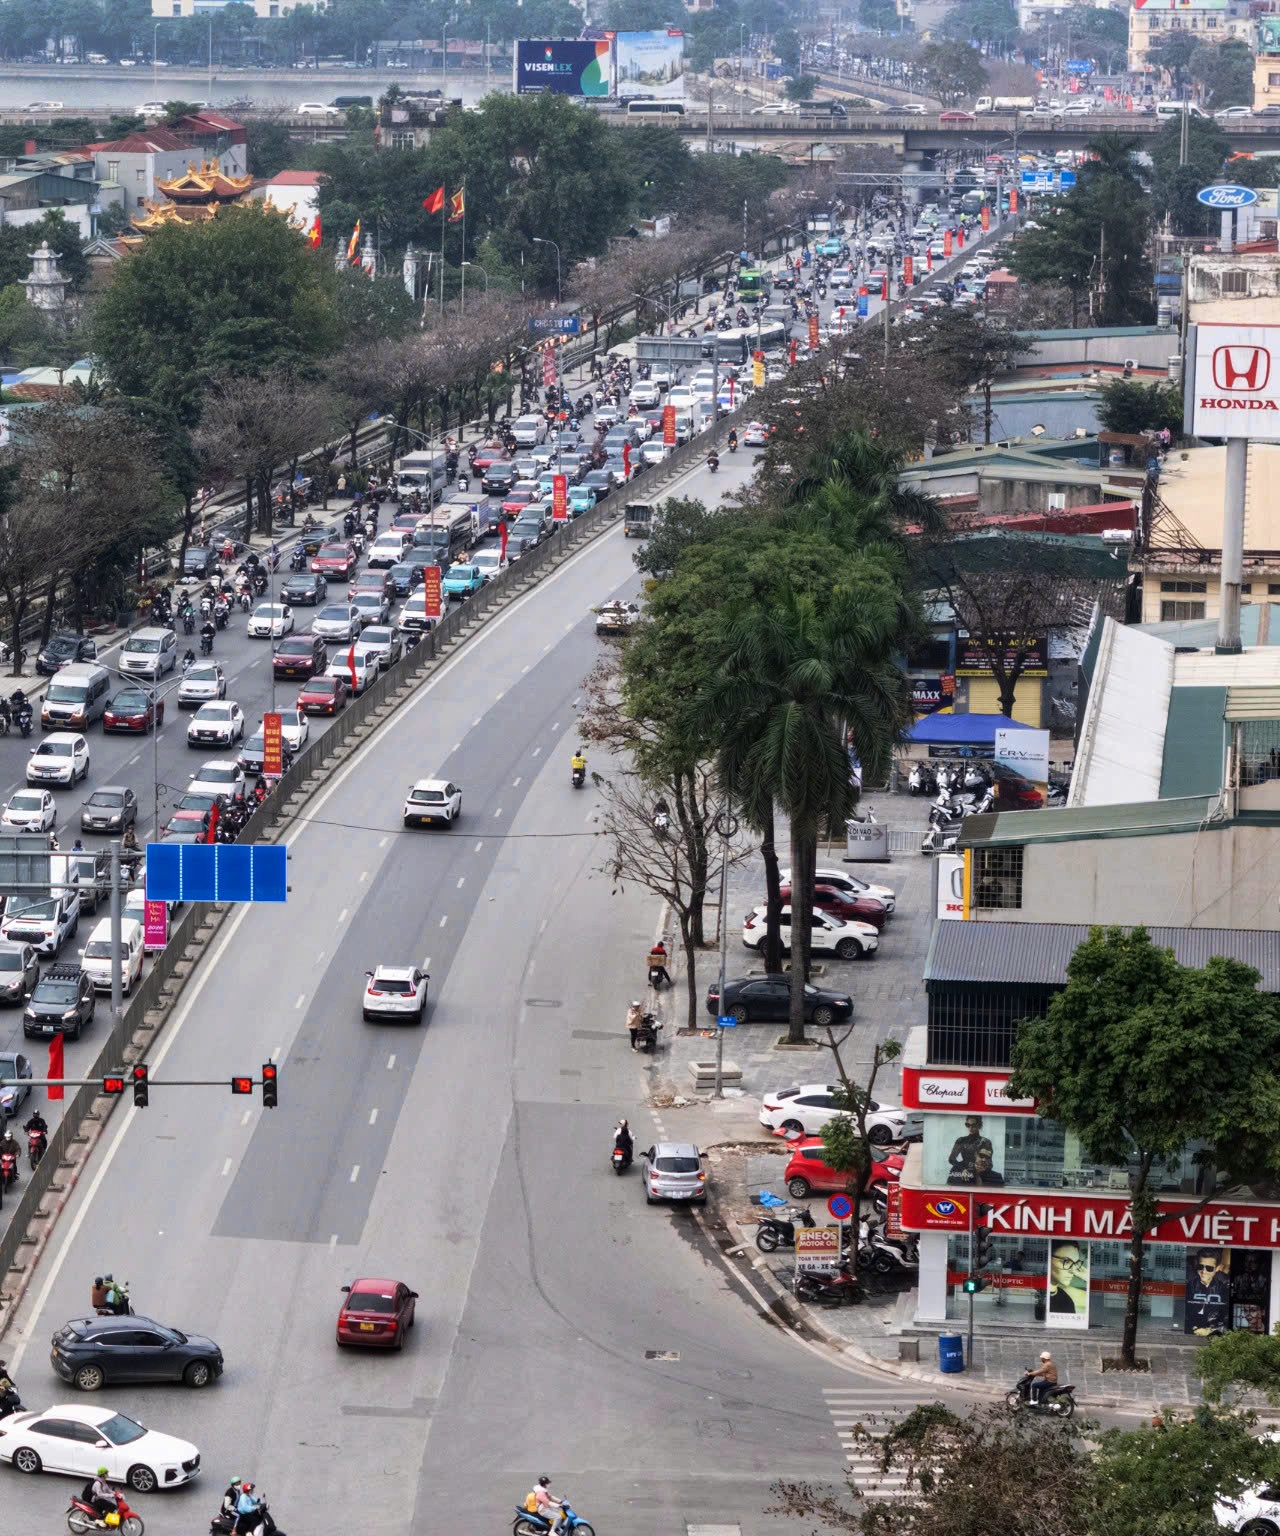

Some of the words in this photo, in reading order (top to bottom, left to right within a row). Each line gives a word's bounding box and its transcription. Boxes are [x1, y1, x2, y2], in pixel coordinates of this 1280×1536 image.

[524, 63, 572, 72] VISENLEX
[1209, 188, 1246, 204] Ford
[1200, 398, 1279, 411] HONDA
[922, 1083, 965, 1098] Chopard
[987, 1199, 1072, 1232] KÍNH
[1179, 1209, 1259, 1245] VIỆT
[799, 1231, 838, 1241] ENEOS
